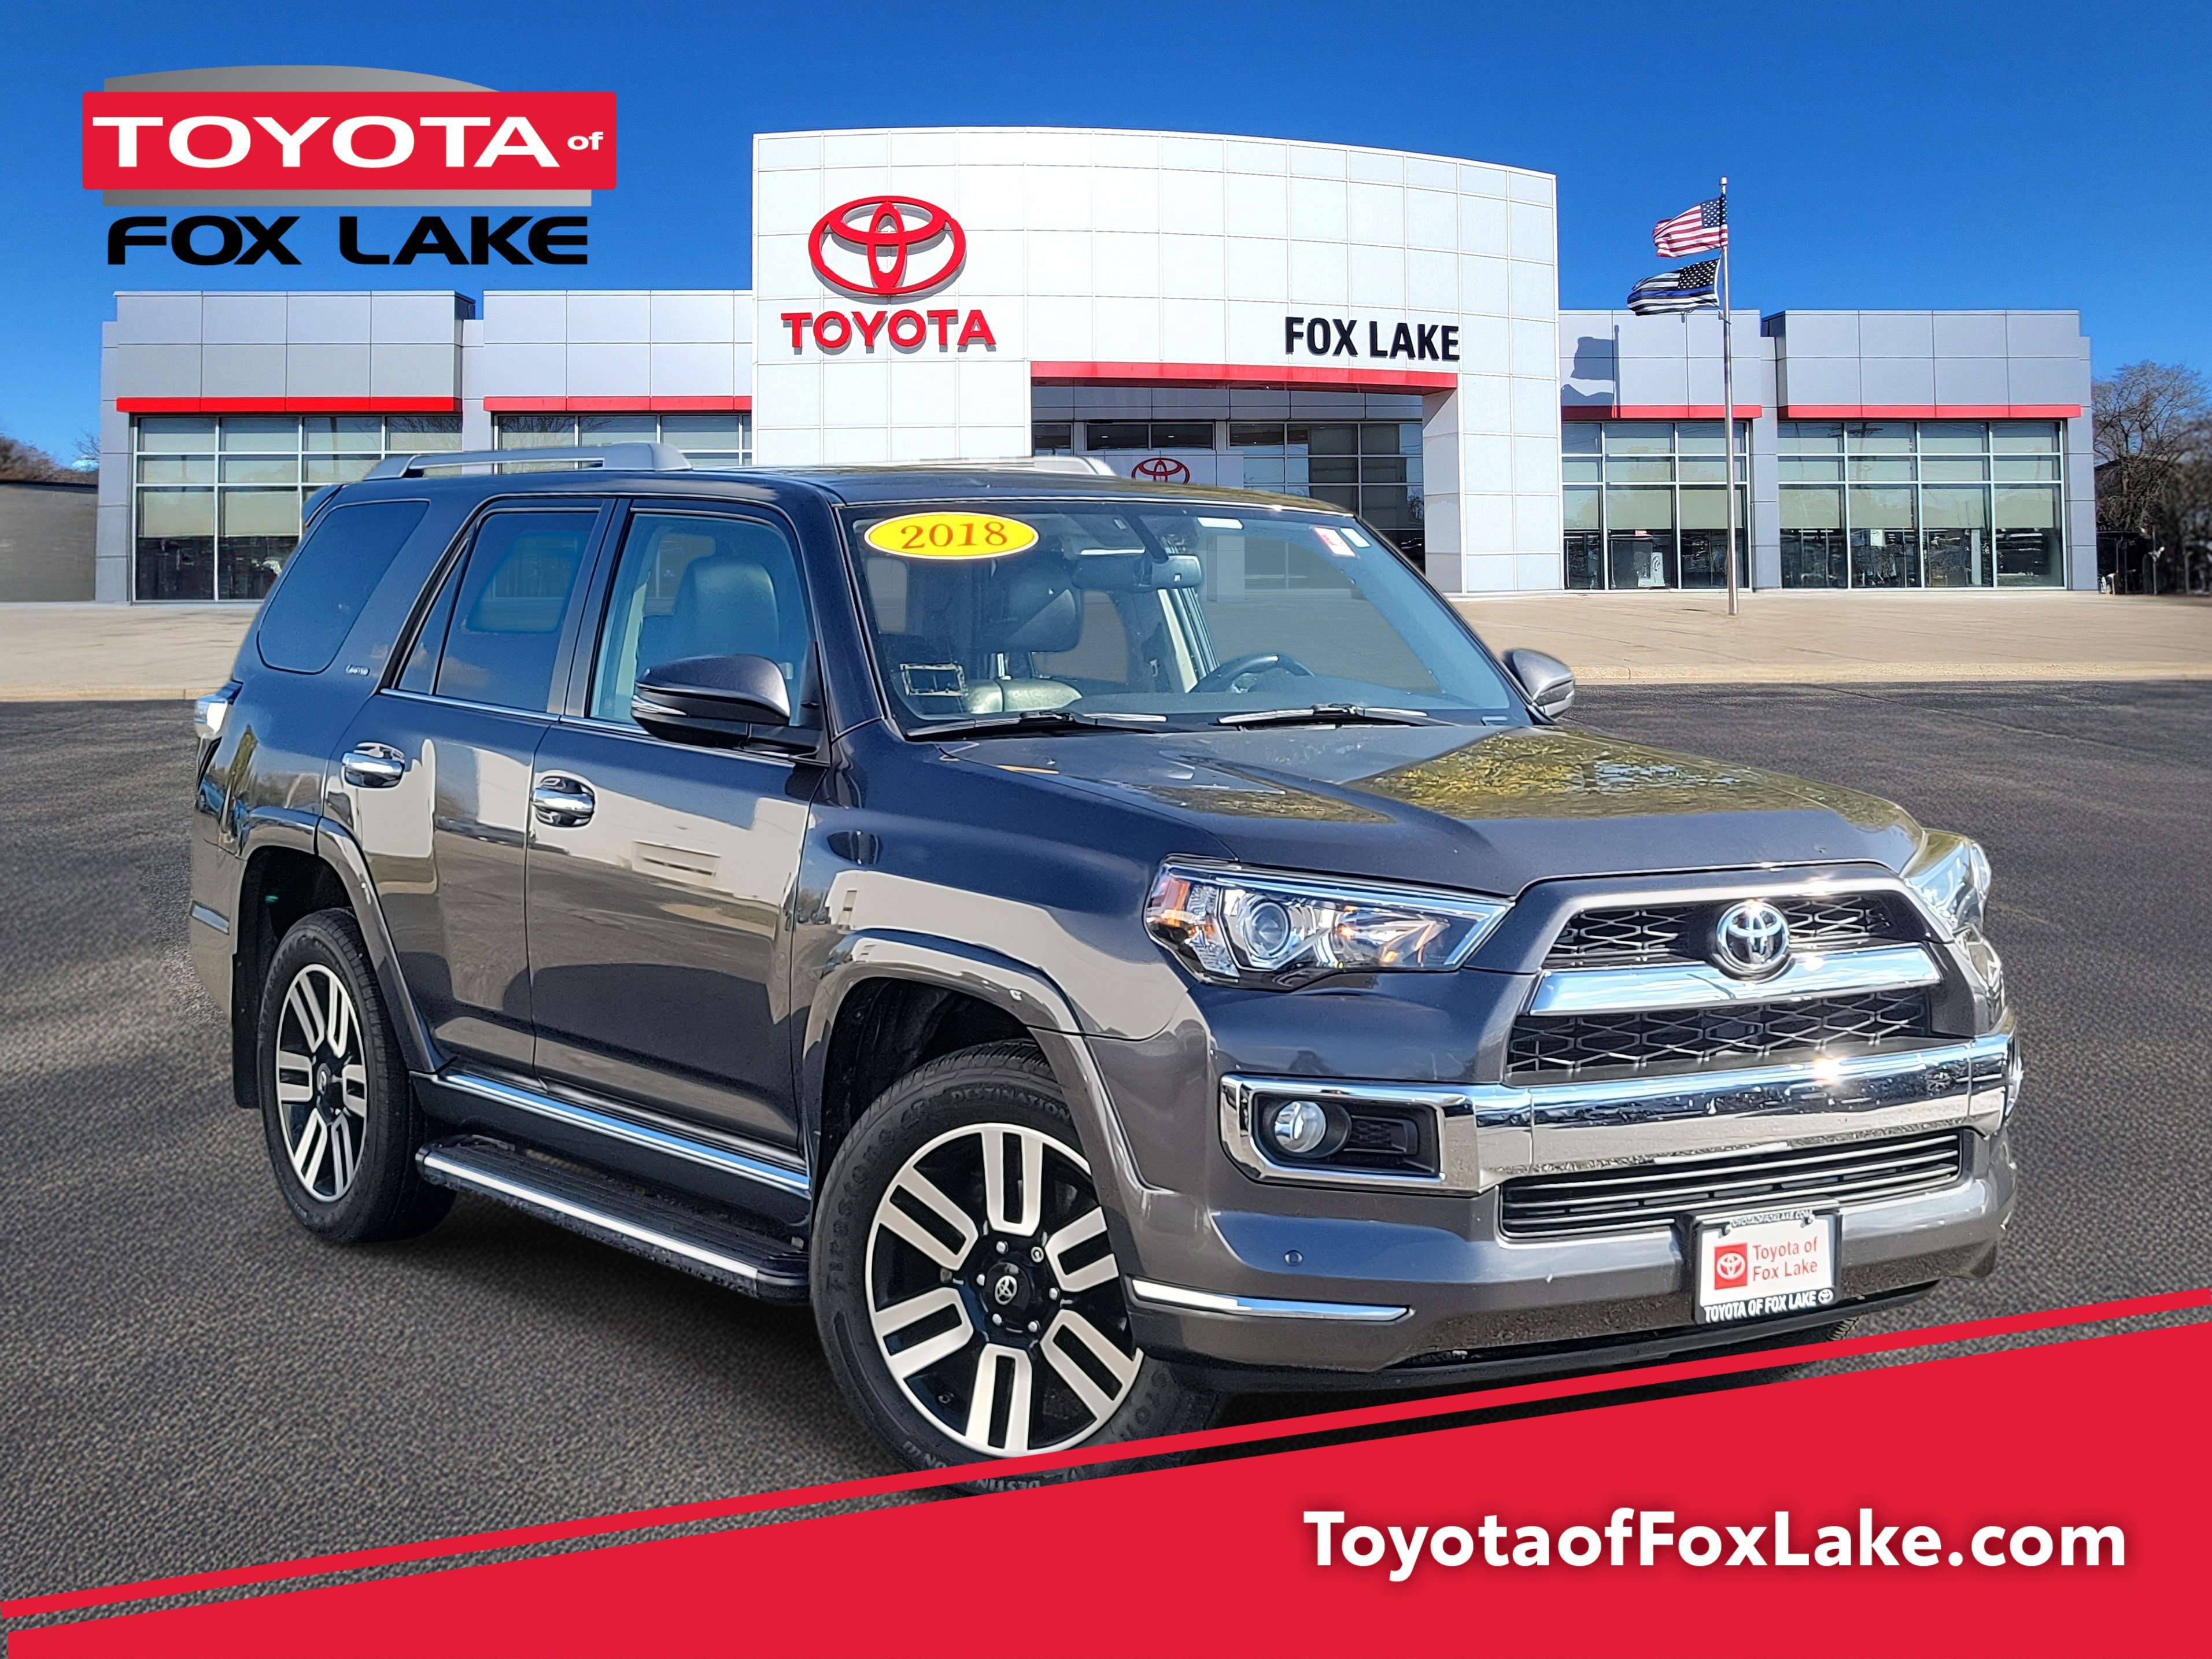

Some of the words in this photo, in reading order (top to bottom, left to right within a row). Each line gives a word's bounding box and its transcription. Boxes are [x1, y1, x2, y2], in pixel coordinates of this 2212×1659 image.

[781, 309, 997, 354] TOYOTA
[1285, 316, 1358, 357] FOX
[1369, 321, 1460, 361] LAKE
[900, 521, 1007, 549] 2018
[1752, 1241, 1799, 1263] Toyota
[1804, 1236, 1818, 1253] of
[1753, 1265, 1779, 1282] Fox
[1785, 1258, 1818, 1277] Lake
[1704, 1300, 1748, 1323] TOYOTA
[1748, 1298, 1763, 1317] OF
[1764, 1295, 1788, 1314] FOX
[1788, 1290, 1817, 1310] LAKE
